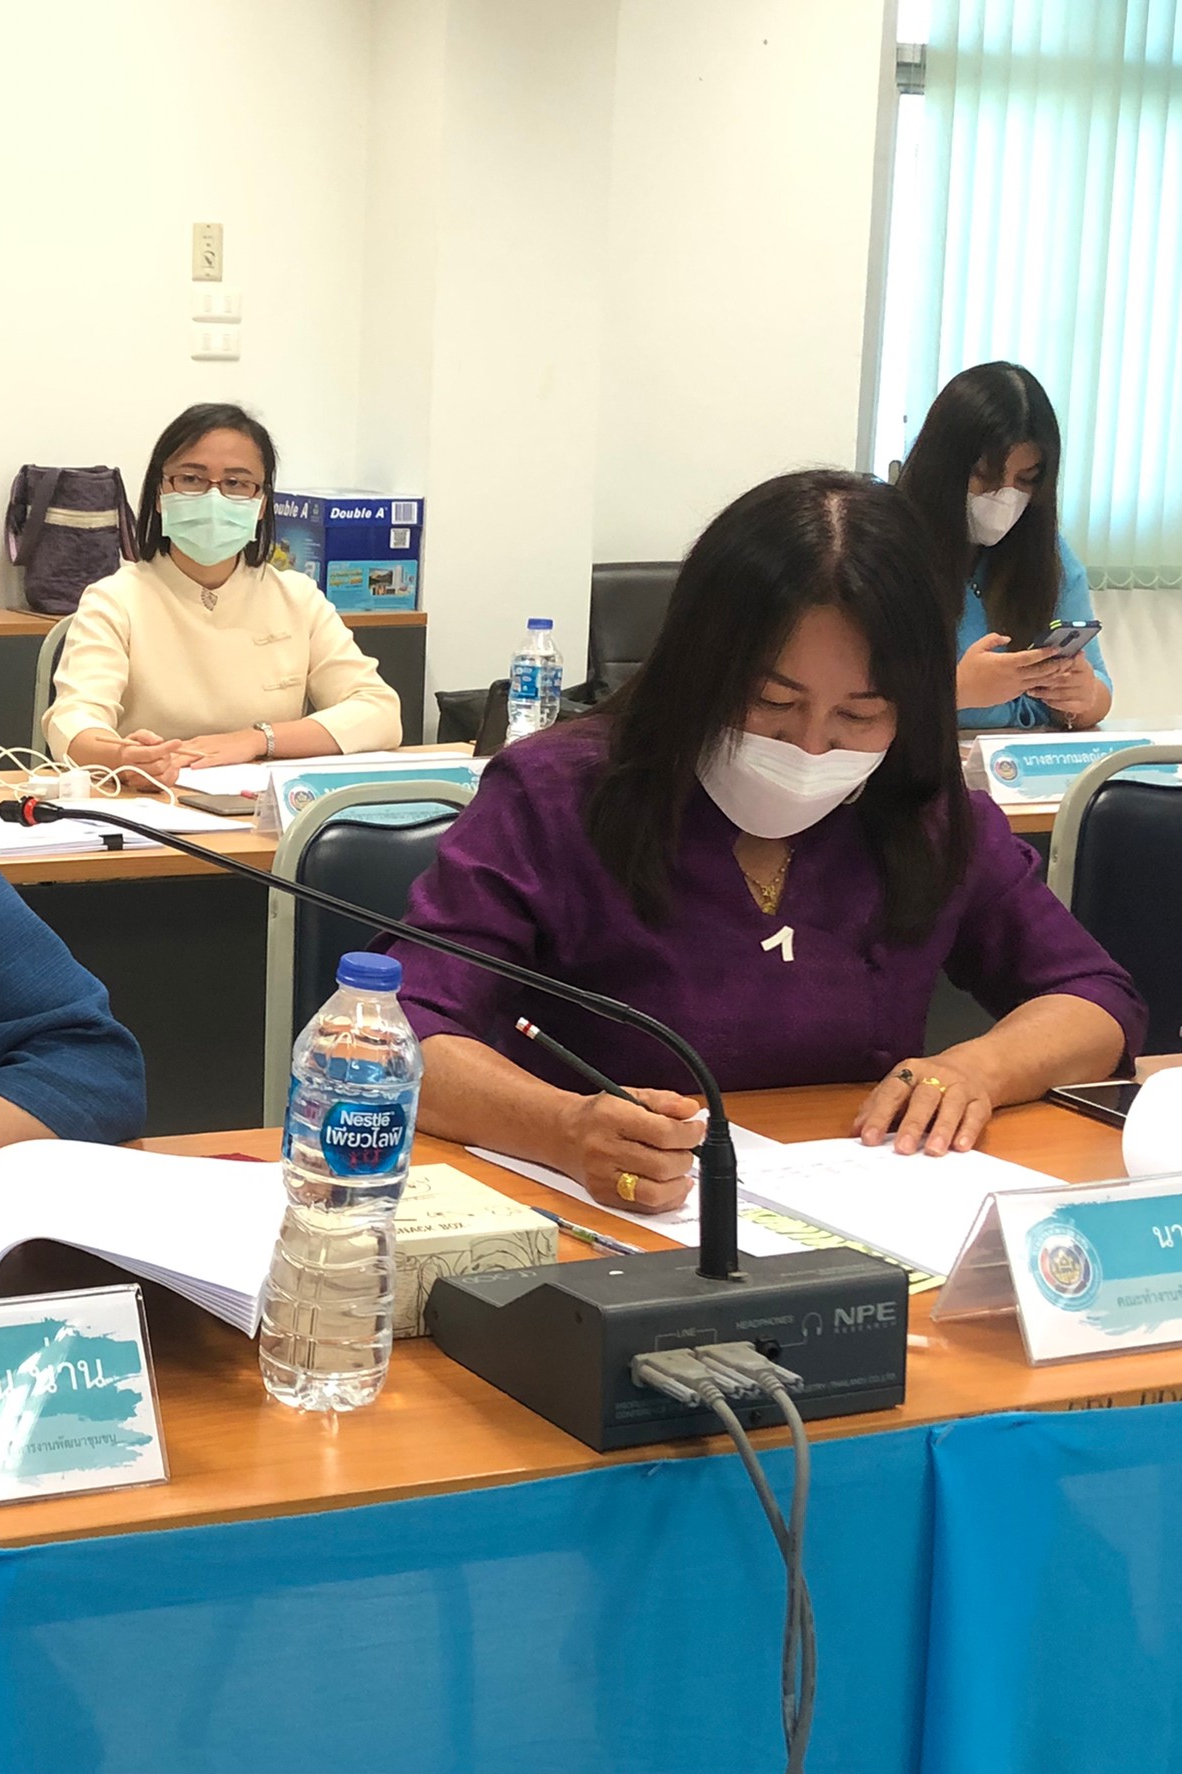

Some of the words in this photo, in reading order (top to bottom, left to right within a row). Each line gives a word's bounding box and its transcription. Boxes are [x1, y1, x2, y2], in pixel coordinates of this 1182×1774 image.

[274, 501, 298, 517] ouble
[300, 503, 309, 519] A
[330, 507, 371, 519] Double
[375, 508, 385, 518] A
[397, 1225, 433, 1235] NACK
[834, 1302, 897, 1327] NPE
[736, 1315, 795, 1330] HEADPHONES
